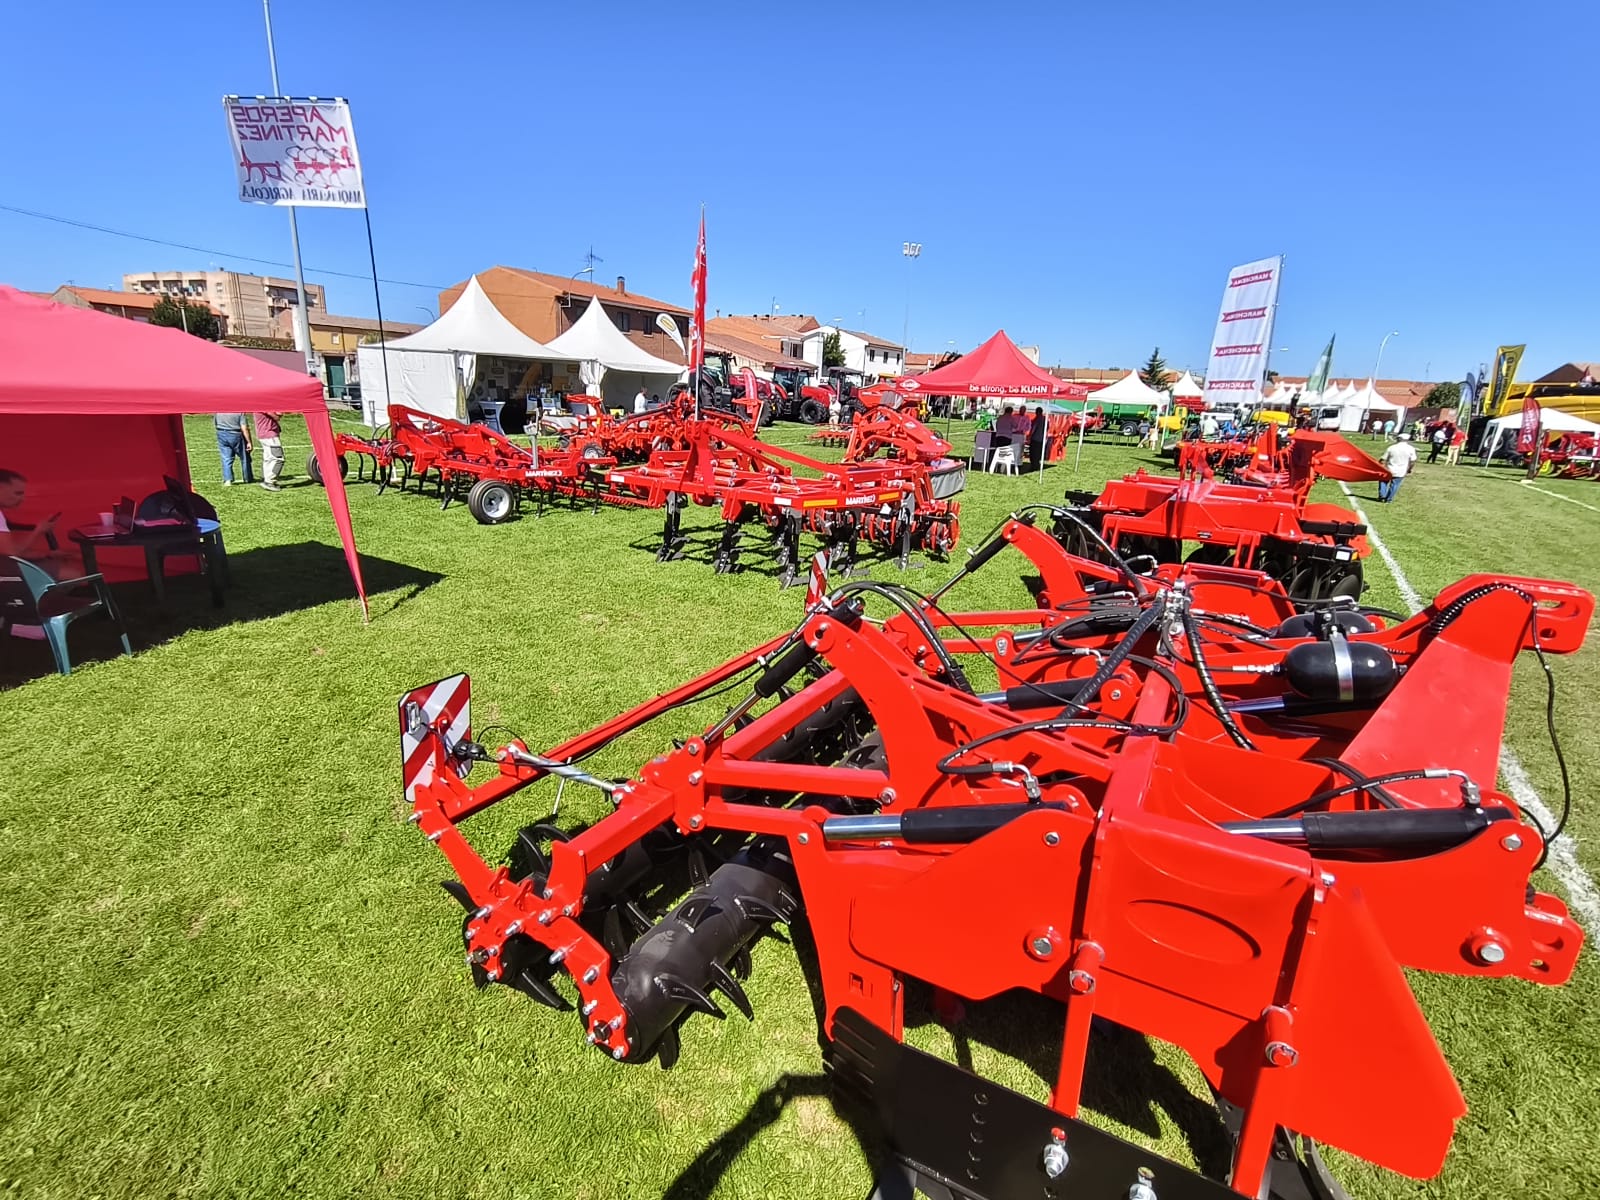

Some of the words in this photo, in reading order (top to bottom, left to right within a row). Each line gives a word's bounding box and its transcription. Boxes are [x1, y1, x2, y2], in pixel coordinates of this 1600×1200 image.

[969, 384, 979, 392] be
[1008, 385, 1020, 393] be
[1020, 385, 1048, 393] KUHN
